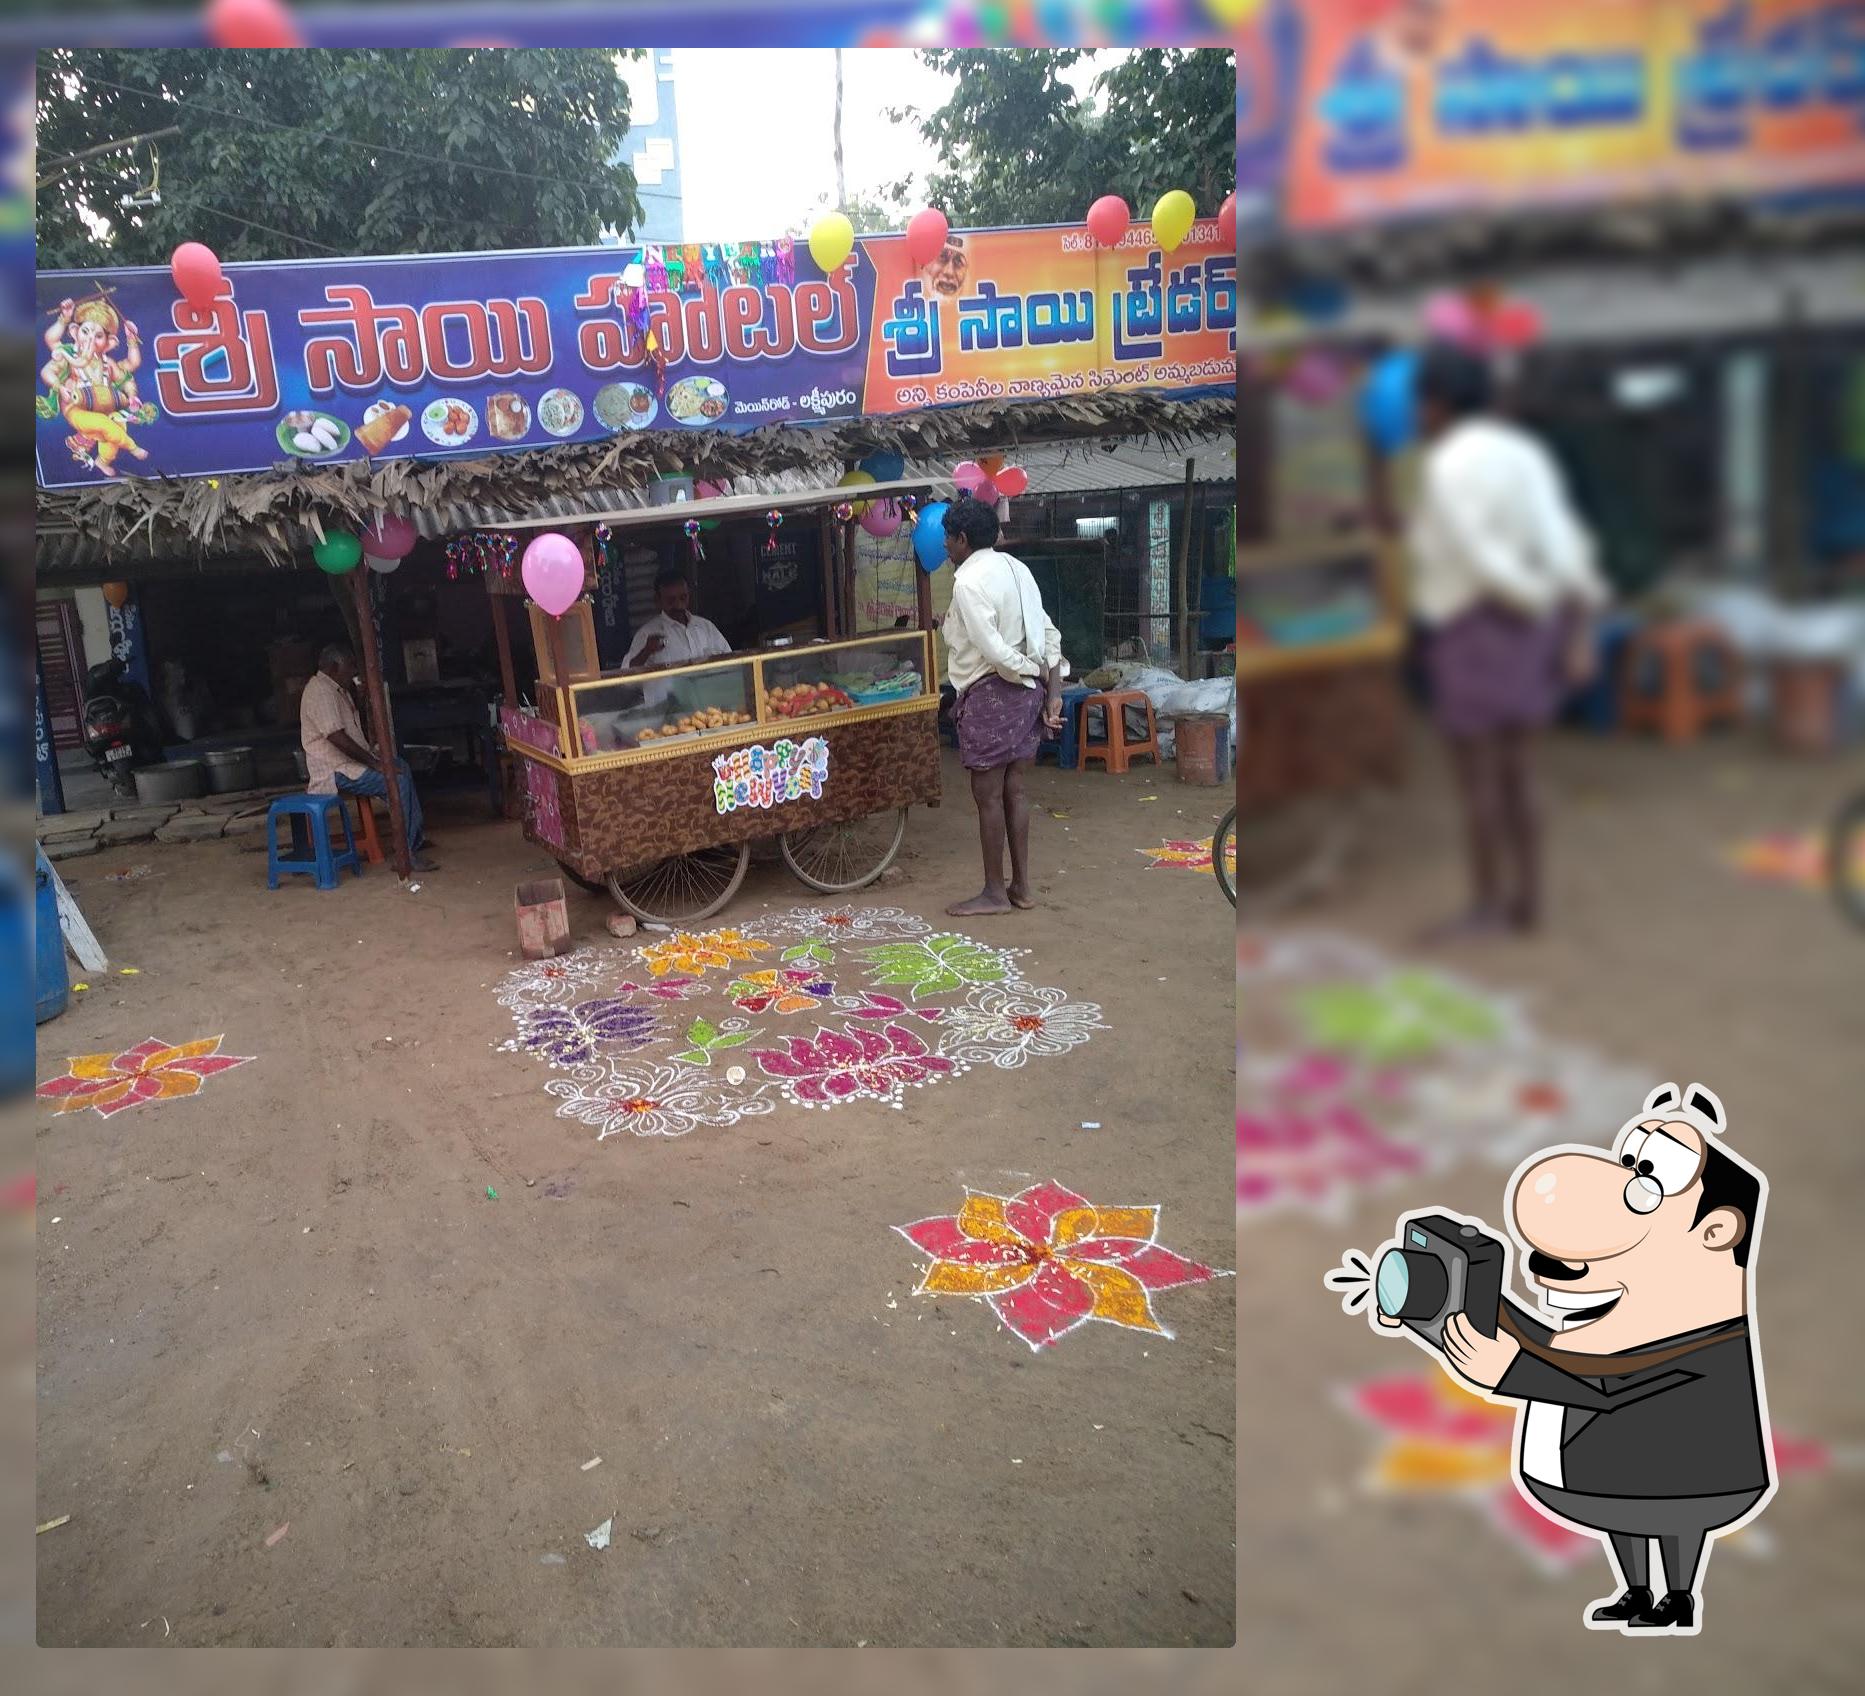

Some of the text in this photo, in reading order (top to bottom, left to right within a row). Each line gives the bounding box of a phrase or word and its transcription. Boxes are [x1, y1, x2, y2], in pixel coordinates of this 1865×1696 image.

[156, 252, 860, 416] శ్రీ సాయి హోటల్
[882, 250, 1236, 378] శ్రీ సాయి ట్రేడర్
[896, 358, 1236, 407] అన్ని కంపెనీల నాణ్యమైన సిమెంట్ అమ్మబడున
